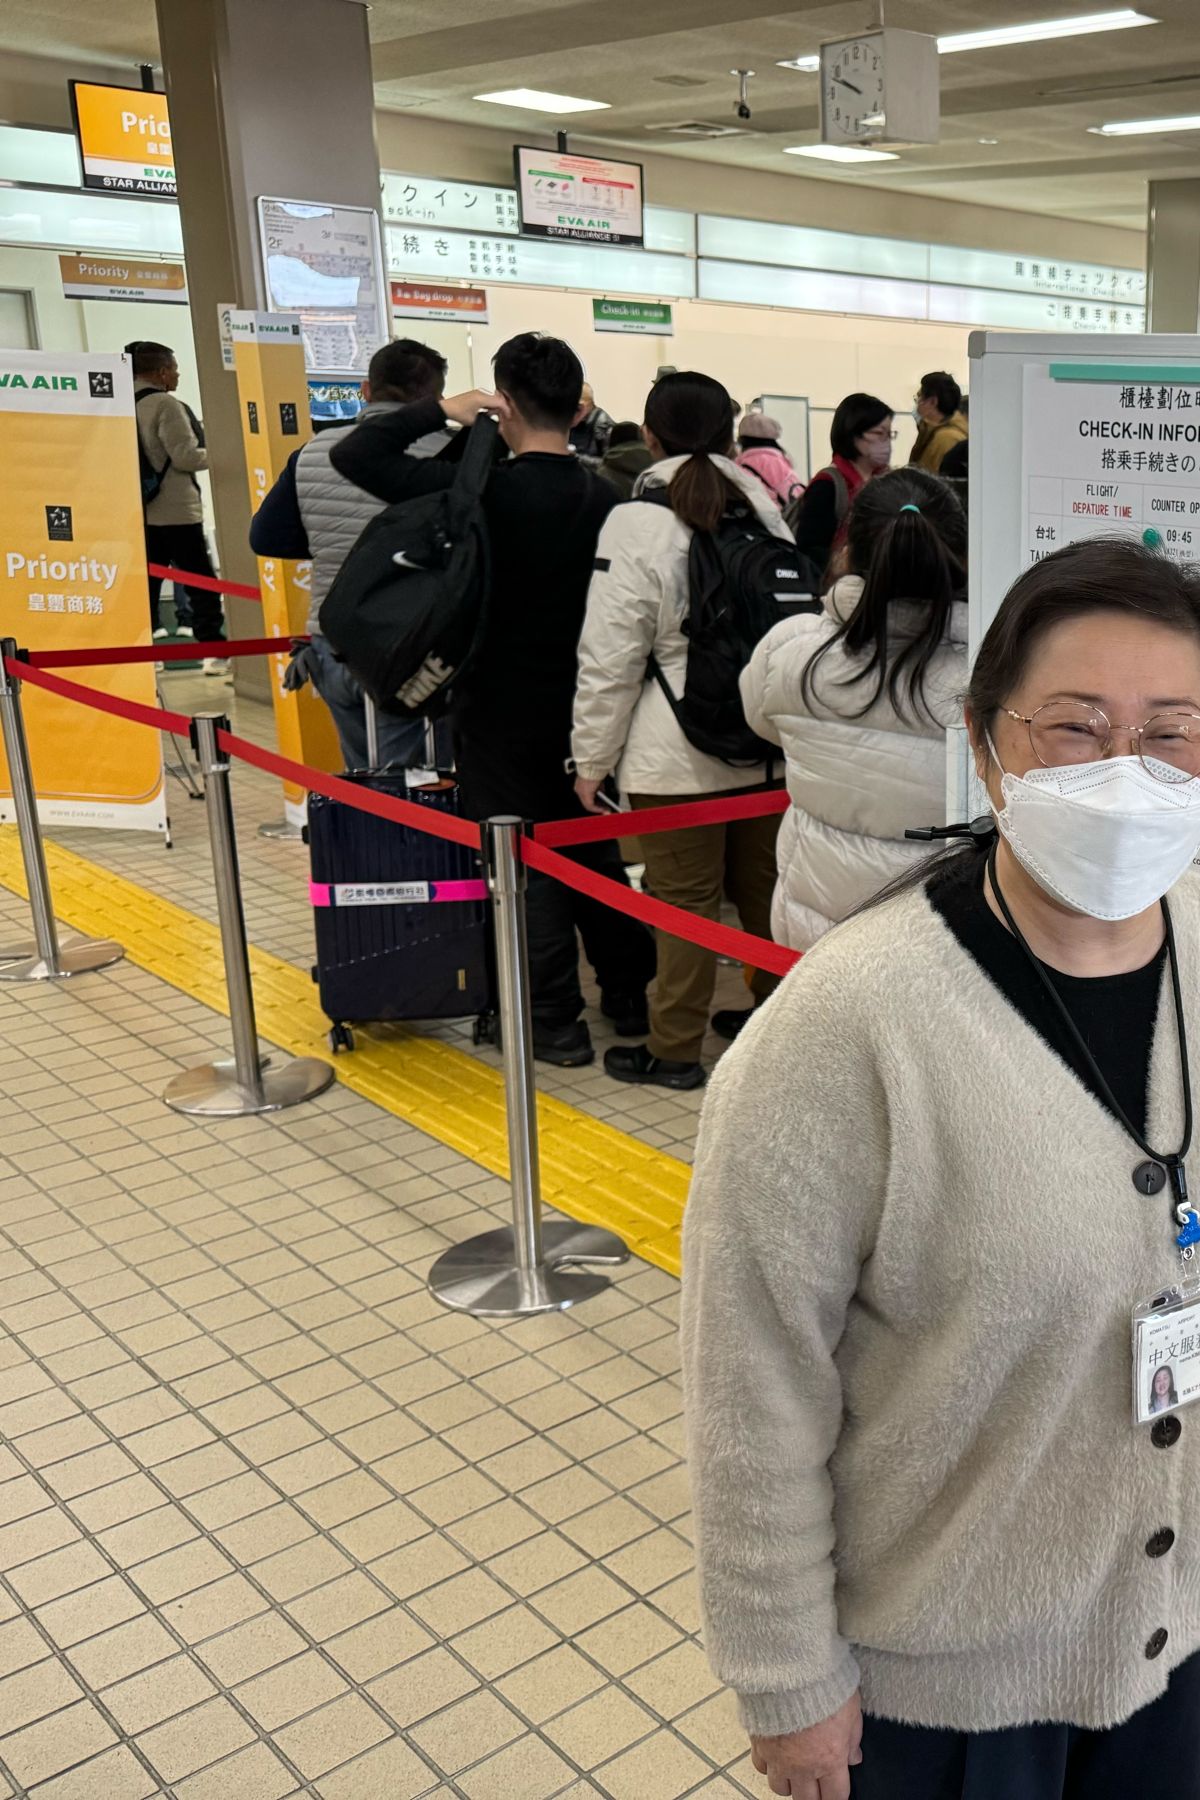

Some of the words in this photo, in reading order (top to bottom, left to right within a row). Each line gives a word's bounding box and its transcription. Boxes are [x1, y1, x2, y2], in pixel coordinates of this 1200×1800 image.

[121, 111, 171, 138] Prio
[103, 177, 134, 189] STAR
[136, 182, 178, 193] ALLIAN
[557, 216, 585, 227] EVA
[587, 219, 611, 229] AIR
[546, 227, 570, 236] STAR
[78, 263, 129, 280] Priority
[0, 374, 29, 388] VA
[32, 375, 78, 391] AIR
[1079, 420, 1154, 440] CHECK-IN
[1086, 484, 1119, 498] FLIGHT/
[1072, 502, 1110, 516] DEPATURE
[1114, 505, 1132, 518] TIME
[1151, 499, 1186, 513] COUNTER
[1035, 525, 1056, 540] 台北
[1166, 529, 1192, 544] 09:45
[6, 552, 118, 590] Priority
